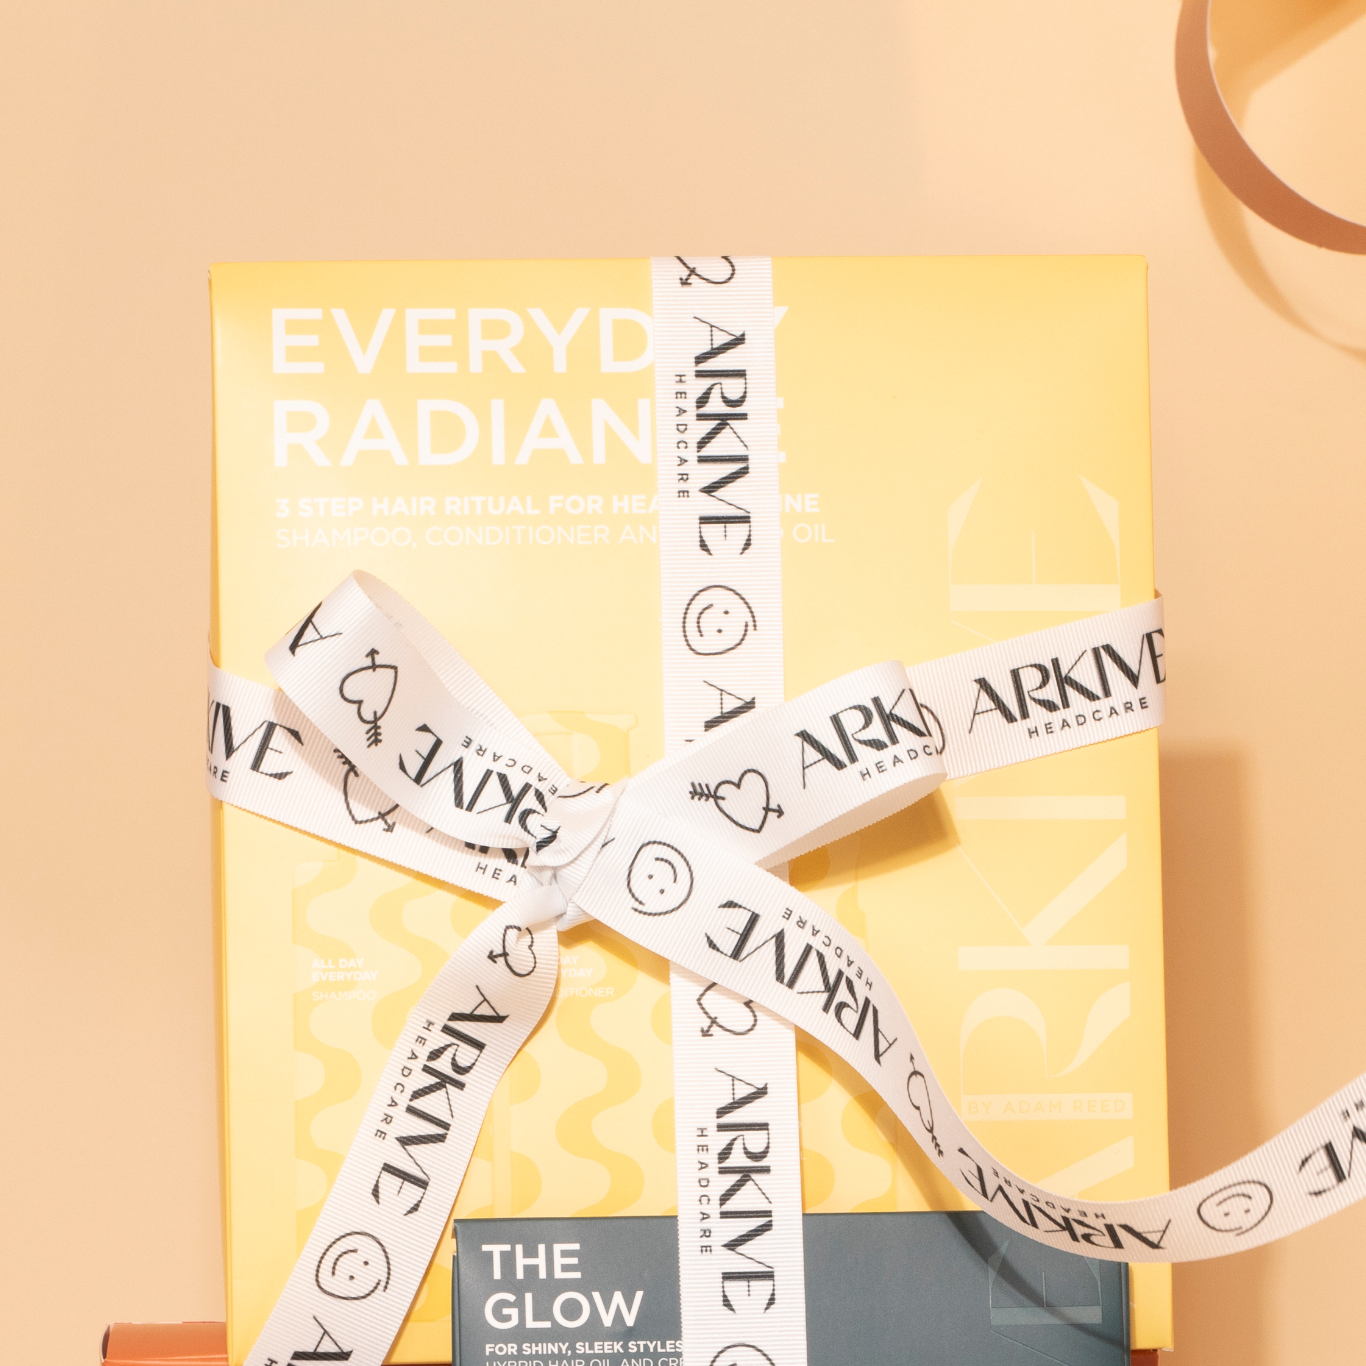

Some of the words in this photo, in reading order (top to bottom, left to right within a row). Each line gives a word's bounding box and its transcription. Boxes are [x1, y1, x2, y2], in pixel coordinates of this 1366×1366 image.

[272, 306, 789, 374] EVERYD
[273, 398, 786, 468] RADIAN
[674, 373, 690, 498] HEADCARE
[693, 316, 753, 556] ARKIVE
[275, 498, 289, 518] 3
[298, 497, 364, 518] STEP
[372, 496, 436, 517] HAIR
[445, 495, 541, 516] RITUAL
[549, 494, 604, 515] FOR
[276, 526, 416, 549] SHAMPOO,
[425, 525, 610, 546] CONDITIONER
[619, 525, 657, 544] AN
[792, 523, 835, 544] OIL
[1028, 697, 1149, 739] HEADCARE
[461, 735, 559, 796] EADCARE
[311, 958, 336, 969] ALL
[339, 957, 364, 969] DAY
[782, 907, 873, 991] HEADCARE
[311, 970, 378, 982] EVERYDAY
[311, 990, 377, 1002] SHAMPOO
[705, 900, 898, 1067] ARKIVE
[371, 985, 510, 1217] ARKIVE
[374, 1018, 436, 1142] HEADCARE
[968, 1100, 993, 1115] BY
[1003, 1100, 1063, 1114] ADAM
[1072, 1099, 1127, 1114] REED
[696, 1128, 713, 1255] HEADCARE
[715, 1067, 776, 1315] ARKIVE
[482, 1243, 582, 1279] THE
[484, 1290, 644, 1329] GLOW
[485, 1343, 519, 1356] FOR
[522, 1342, 573, 1358] SHINY,
[575, 1341, 624, 1354] SLEEK
[628, 1340, 683, 1353] STYLES
